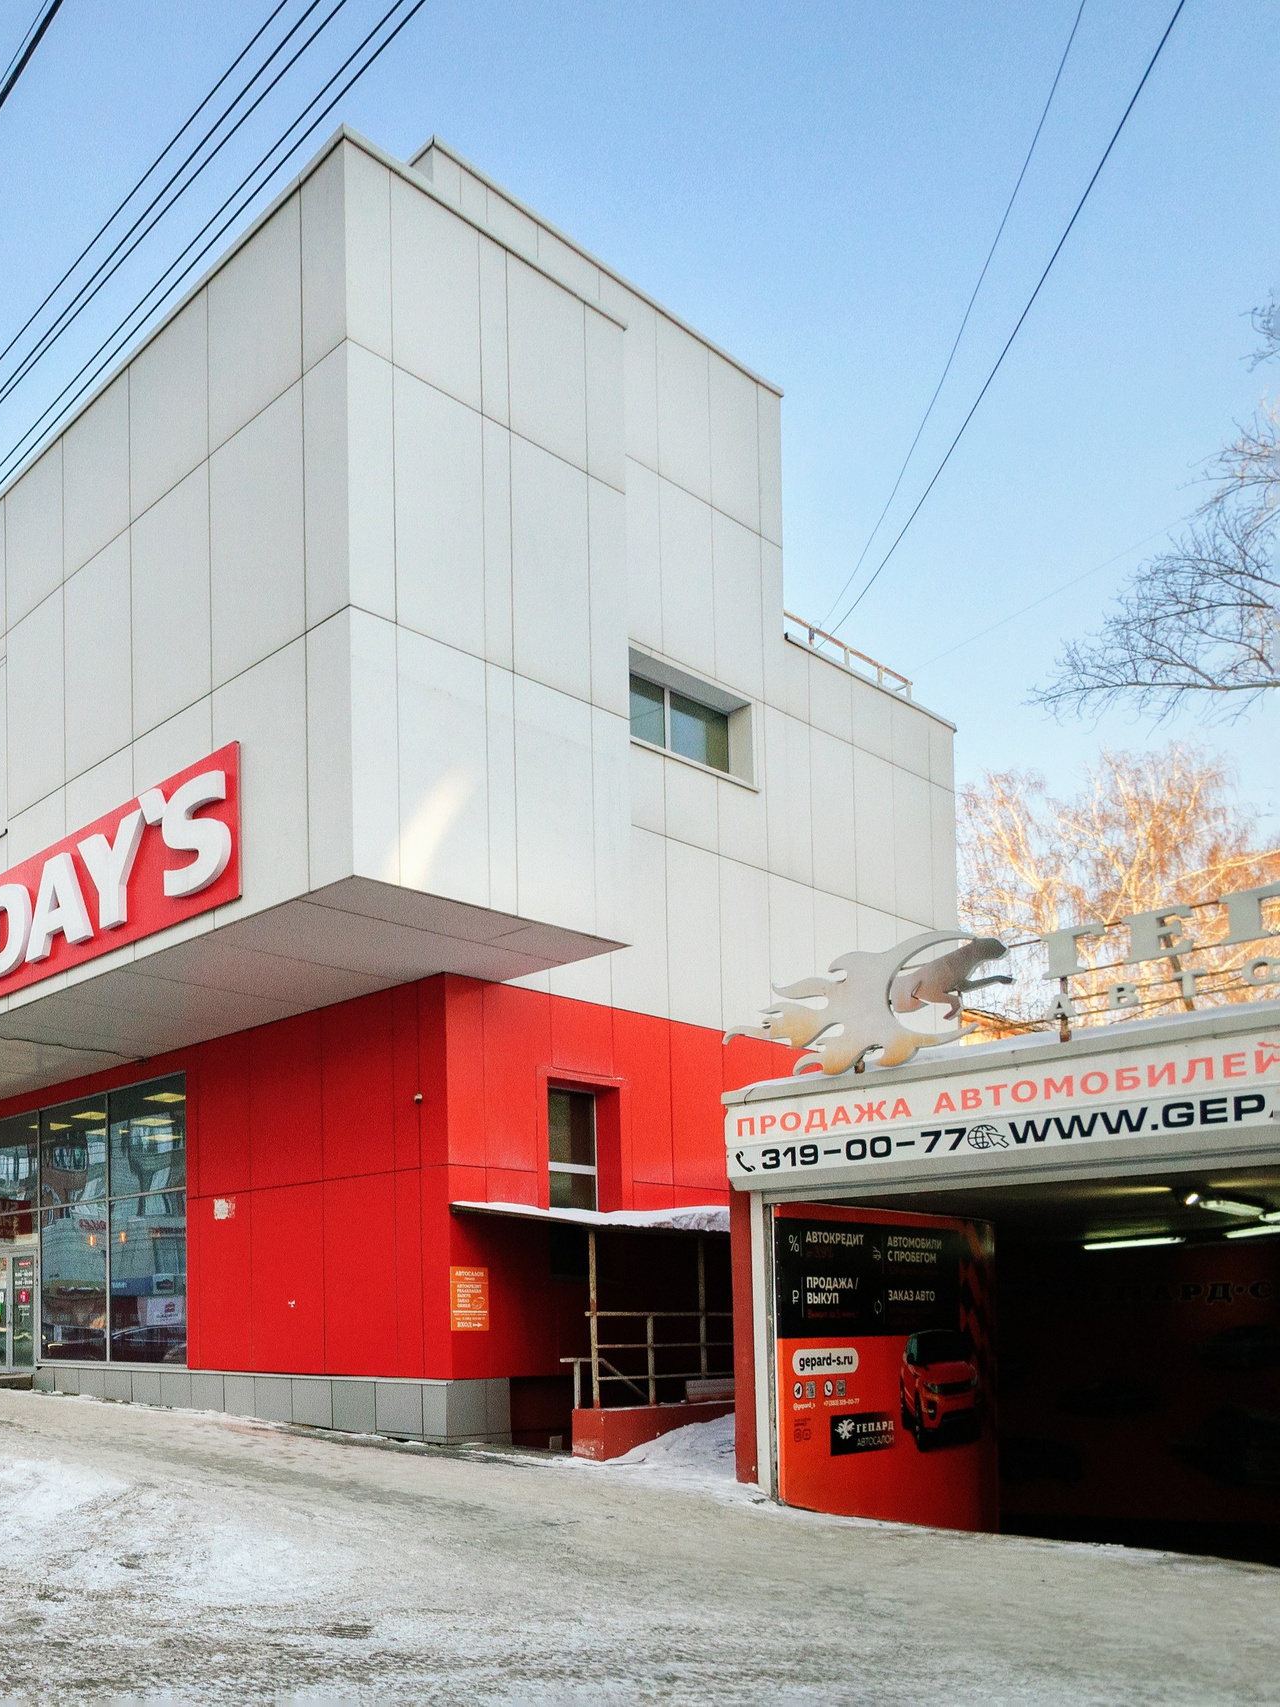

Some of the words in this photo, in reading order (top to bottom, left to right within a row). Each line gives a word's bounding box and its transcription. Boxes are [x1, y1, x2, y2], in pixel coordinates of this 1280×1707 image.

[737, 1098, 912, 1137] ПРОДАЖА
[932, 1041, 1280, 1115] АВТОМОБИЛЕЙ
[761, 1127, 967, 1170] 319-00-77
[1008, 1093, 1274, 1144] WWW.GEP
[806, 1231, 864, 1246] АВТОКРЕДИТ
[887, 1235, 942, 1250] АВТОМОБИЛИ
[887, 1251, 893, 1262] С
[894, 1251, 937, 1263] ПРОБЕГОМ
[806, 1277, 853, 1289] ПРОДАЖА
[807, 1292, 839, 1305] ВЫКУП
[888, 1290, 913, 1301] ЗАКАЗ
[915, 1290, 935, 1302] АВТО
[799, 1353, 853, 1371] gepard-s.ru
[856, 1421, 895, 1433] ГЕПАРД
[857, 1435, 895, 1447] АВТОСАЛОН
